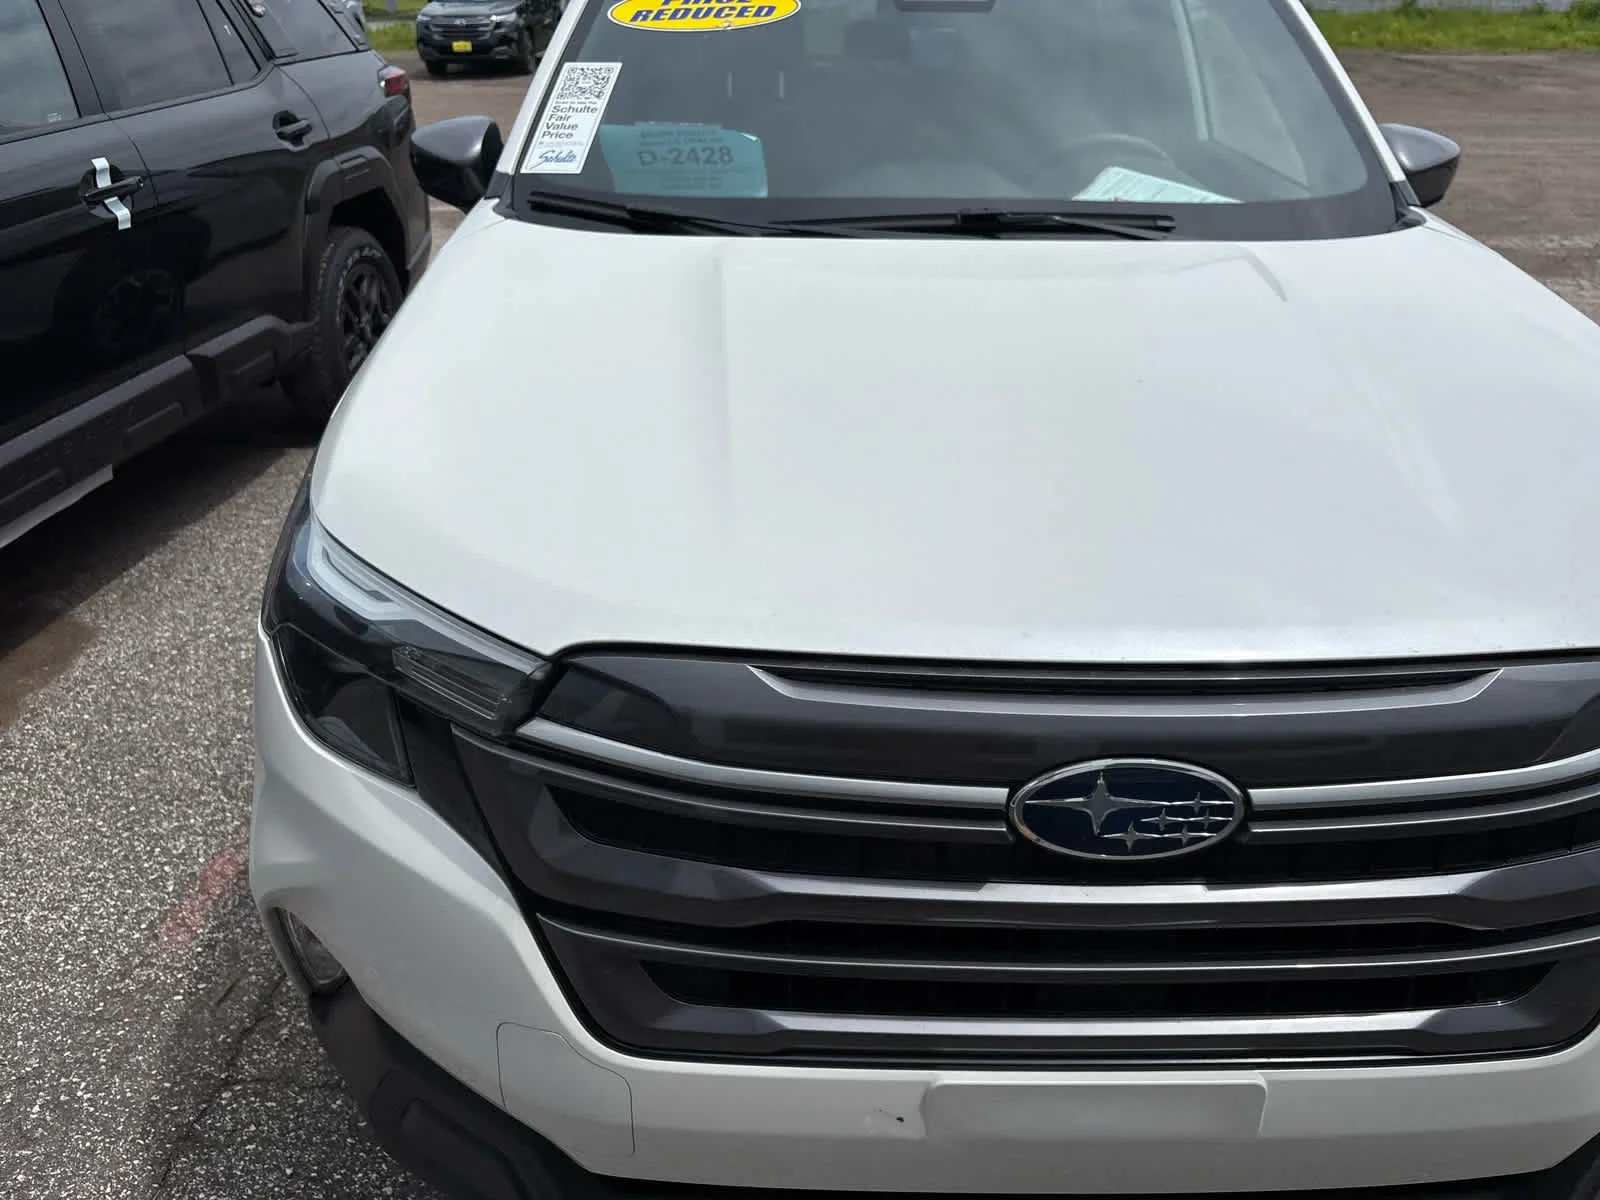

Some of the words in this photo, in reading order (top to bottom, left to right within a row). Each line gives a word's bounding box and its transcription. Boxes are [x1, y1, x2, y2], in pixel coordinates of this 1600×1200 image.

[629, 5, 777, 23] REDUCED
[551, 105, 598, 113] Schulte
[548, 114, 572, 122] Fair
[545, 122, 578, 131] Value
[541, 131, 574, 139] Price
[637, 146, 734, 167] D-2428
